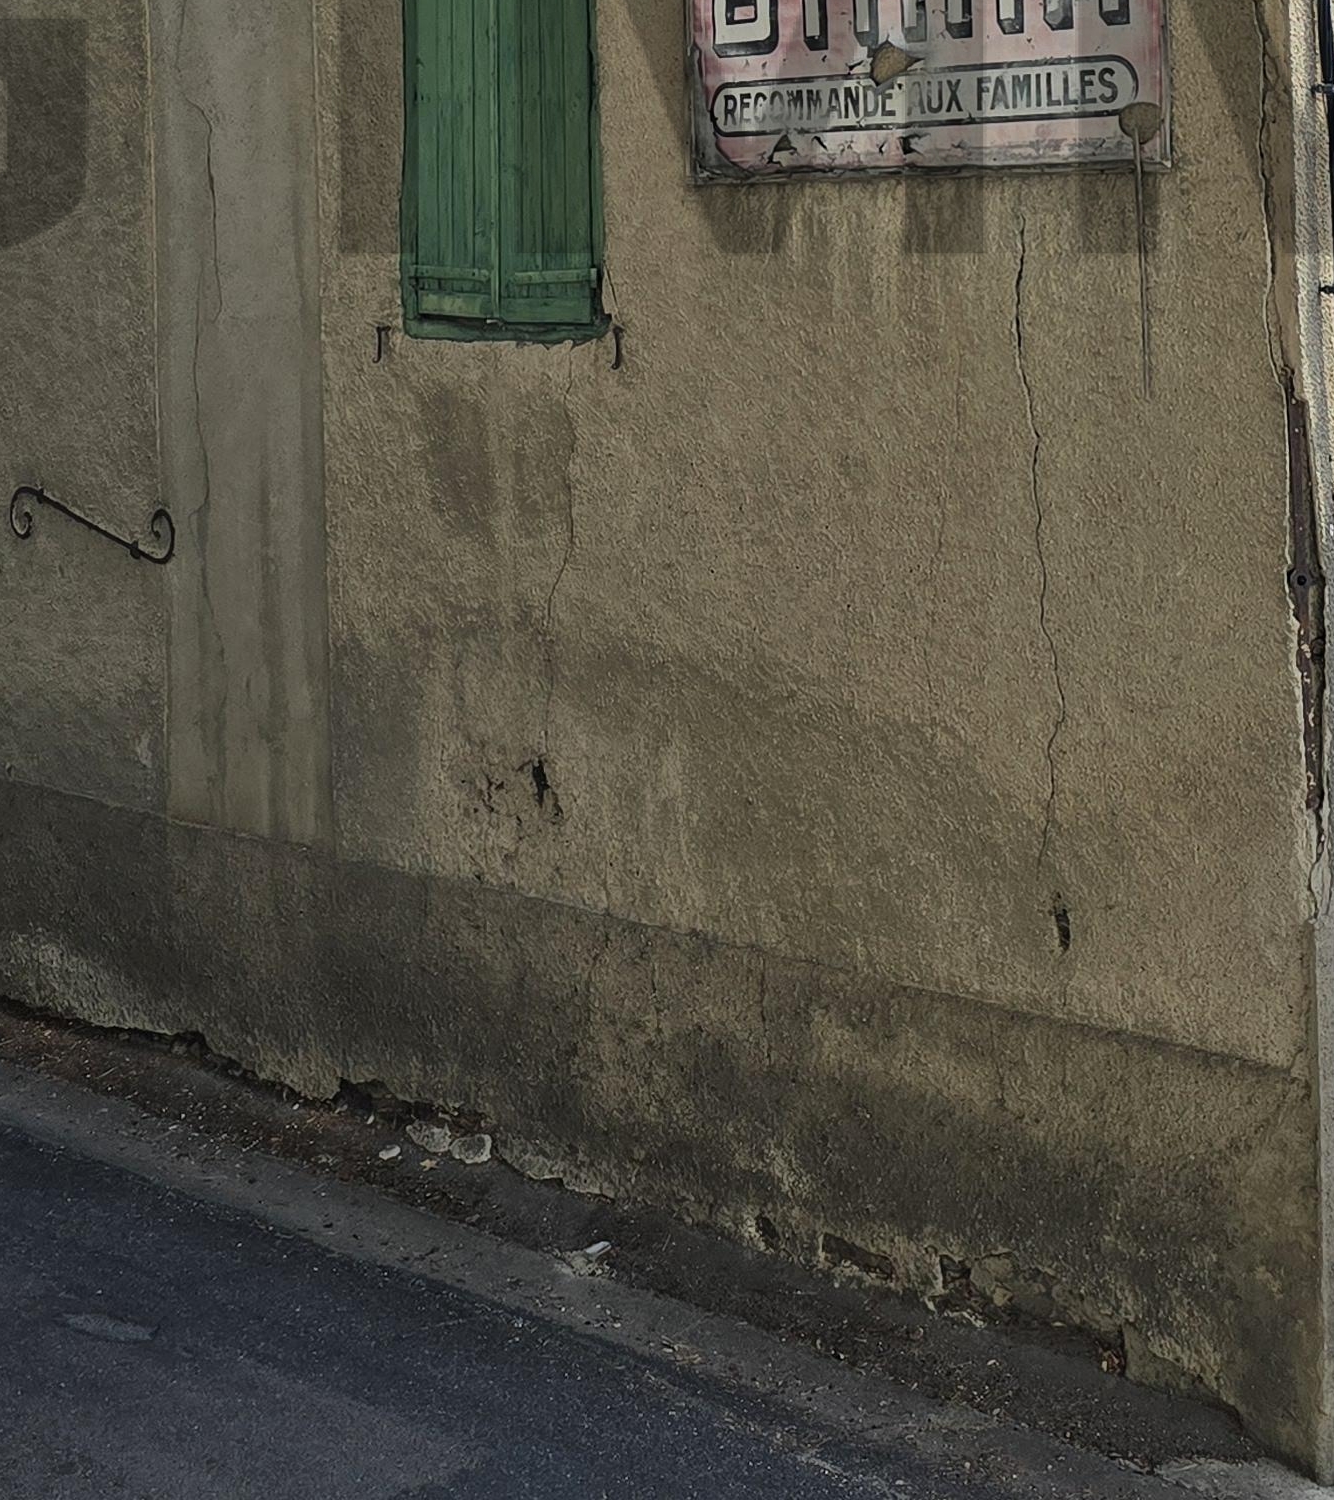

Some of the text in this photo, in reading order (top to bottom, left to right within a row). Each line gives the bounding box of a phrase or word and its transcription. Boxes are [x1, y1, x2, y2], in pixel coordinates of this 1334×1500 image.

[723, 67, 1119, 126] RECOMMANDE AUX FAMILLES
